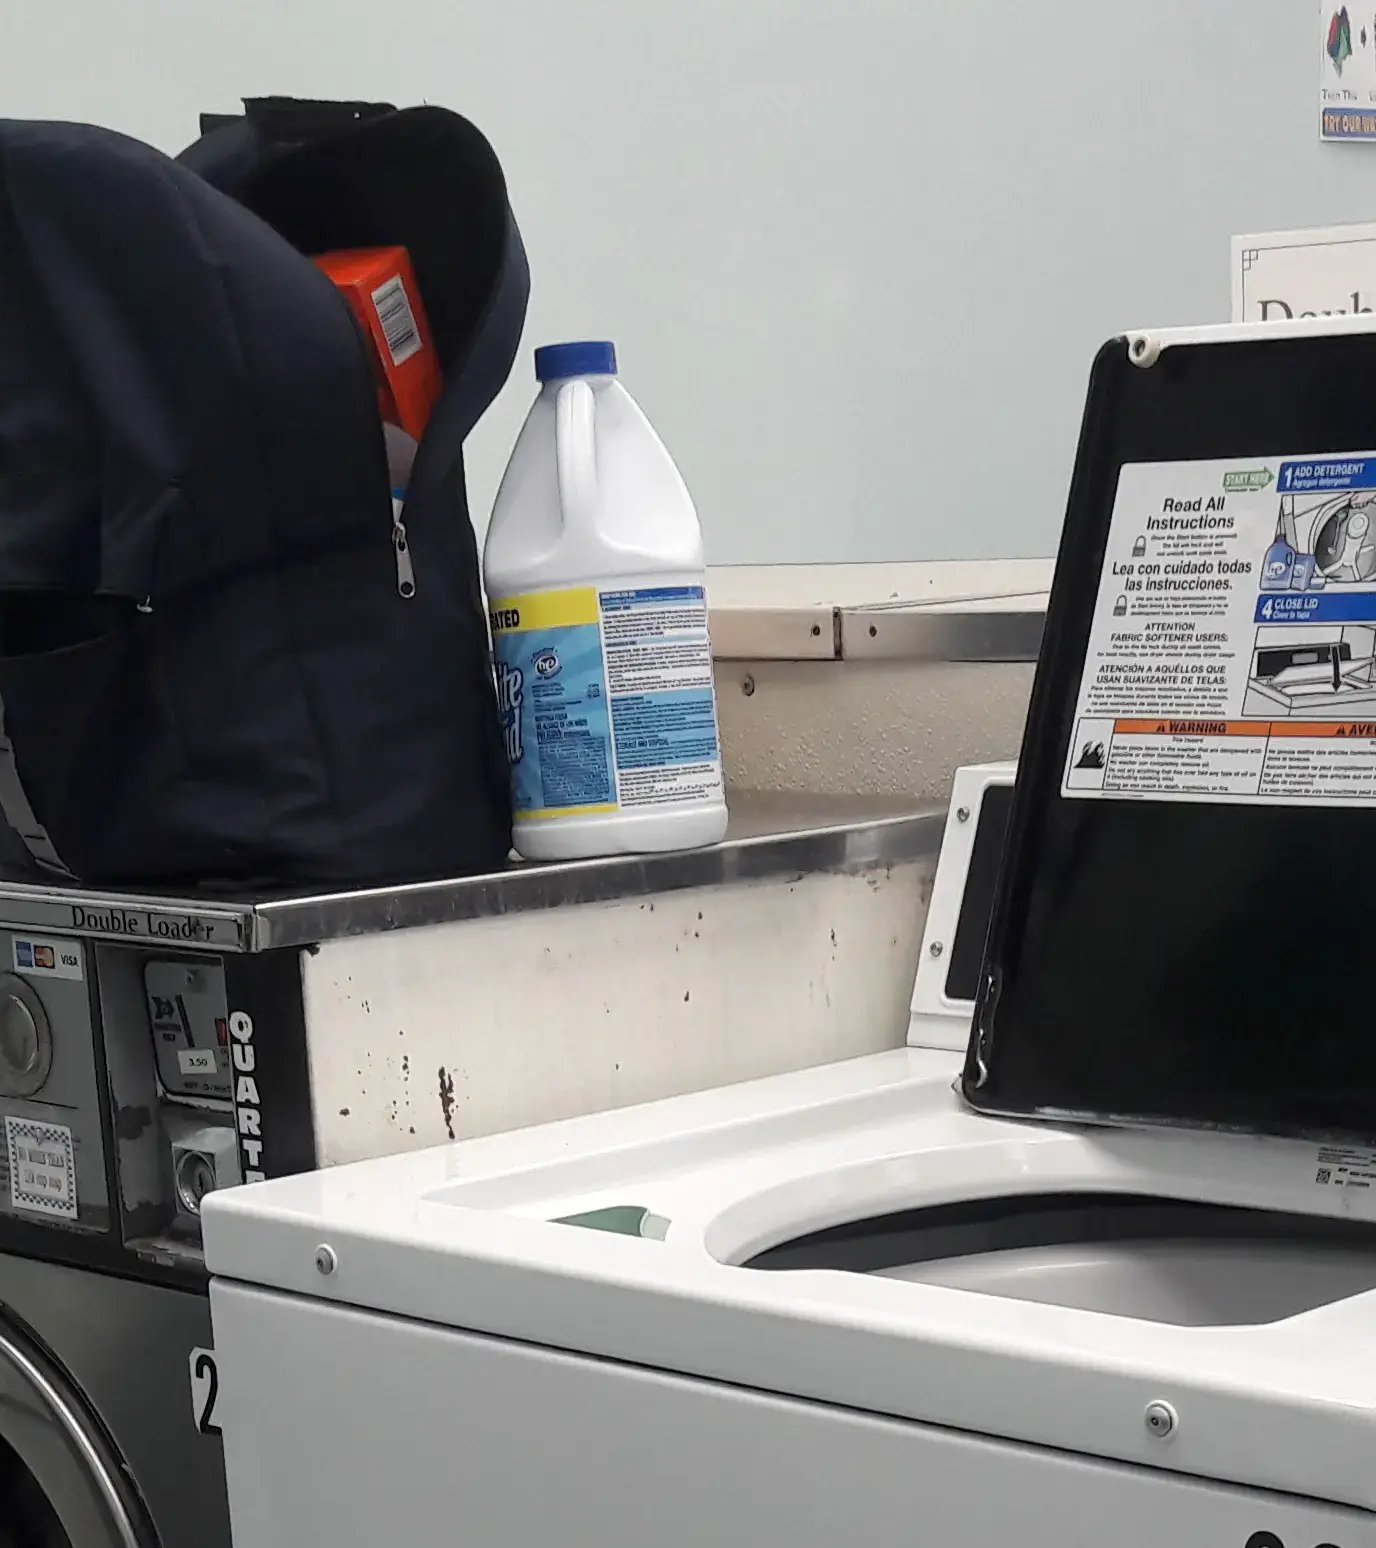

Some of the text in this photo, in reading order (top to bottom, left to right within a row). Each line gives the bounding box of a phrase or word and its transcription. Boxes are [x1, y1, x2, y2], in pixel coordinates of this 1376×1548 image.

[1284, 463, 1365, 488] 1 ADD DETERGENT
[1163, 496, 1225, 513] Read All
[1146, 515, 1234, 530] Instructions
[1113, 559, 1252, 576] Lea con cuidado todas
[1124, 577, 1233, 592] las instrucciones.
[1261, 597, 1319, 620] 4 CLOSE LID
[1144, 622, 1195, 631] ATTENTION
[1110, 633, 1143, 642] FABRIC
[1145, 633, 1194, 642] SOFTENER
[1146, 664, 1153, 673] A
[1155, 662, 1204, 673] AQUÉLLOS
[1206, 664, 1227, 674] QUE
[1096, 675, 1122, 684] USAN
[1124, 675, 1178, 685] SUAVIZANTE
[1180, 675, 1193, 685] DE
[1169, 722, 1227, 733] WARNING
[71, 905, 214, 940] Double Loader
[60, 953, 80, 968] VISA
[188, 1057, 208, 1067] 3.50
